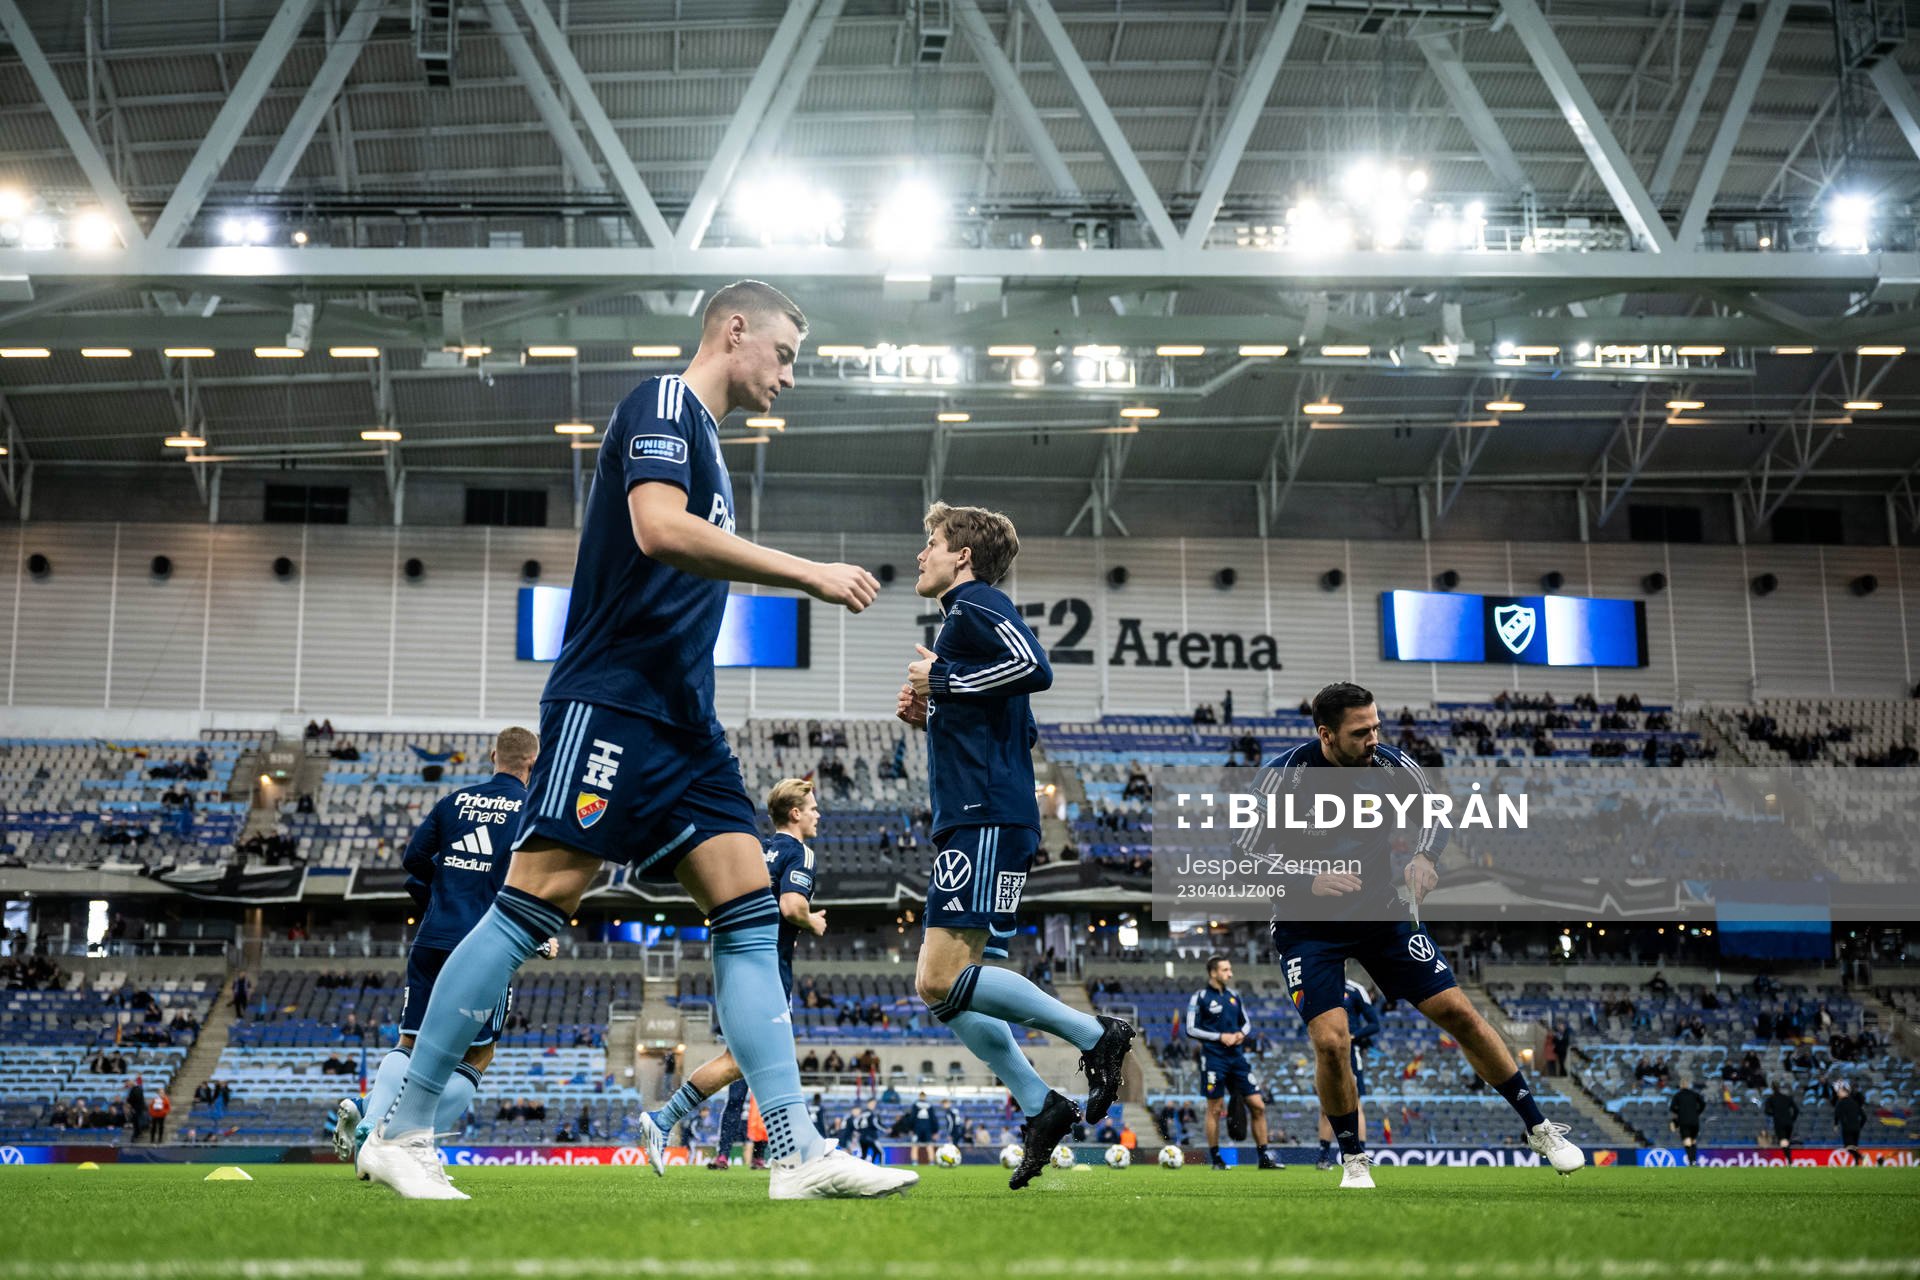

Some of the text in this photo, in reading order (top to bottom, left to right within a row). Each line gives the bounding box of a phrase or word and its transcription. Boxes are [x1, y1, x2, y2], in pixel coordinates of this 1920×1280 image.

[635, 440, 683, 453] UNIBET
[1109, 618, 1281, 671] Arena
[454, 792, 523, 812] Prioritet
[458, 805, 507, 824] Finans
[443, 855, 492, 872] stadium
[456, 1151, 599, 1166] Stockholm
